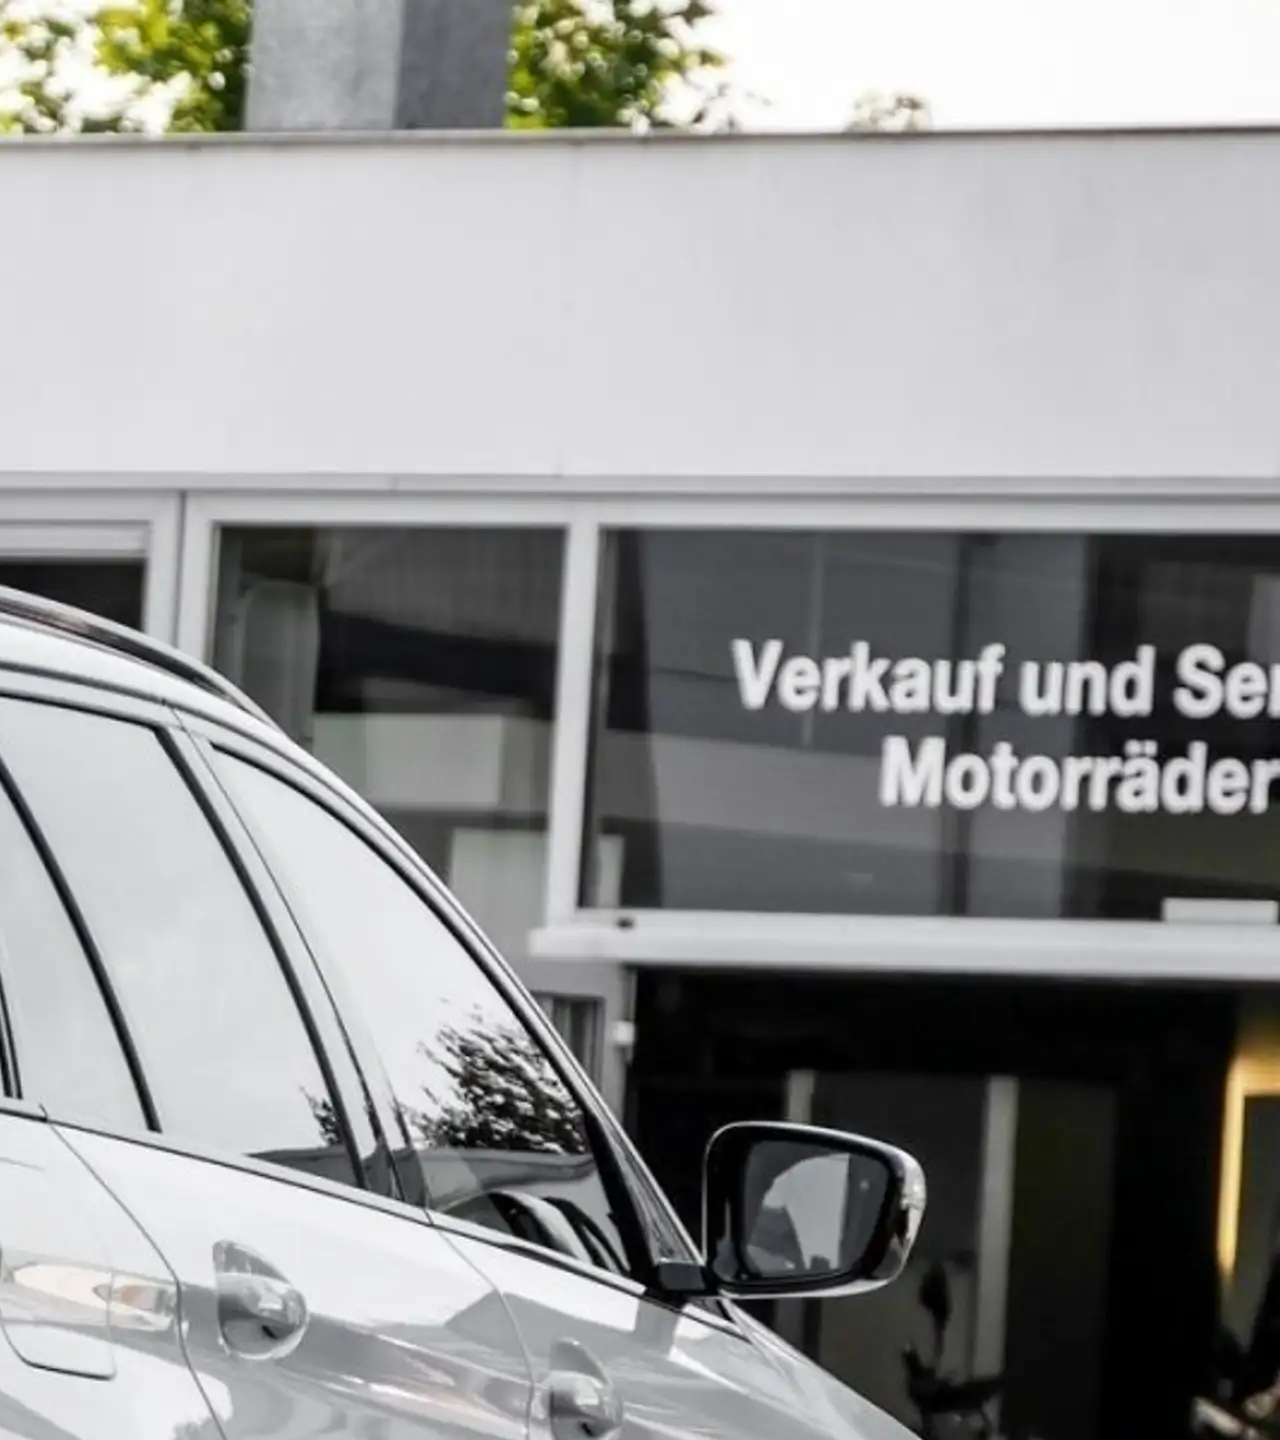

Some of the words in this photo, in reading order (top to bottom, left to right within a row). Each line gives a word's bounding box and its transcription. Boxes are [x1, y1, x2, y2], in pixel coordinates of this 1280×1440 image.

[732, 637, 1006, 711] Verkauf
[1018, 645, 1156, 716] und
[879, 735, 1280, 814] Motorräder
